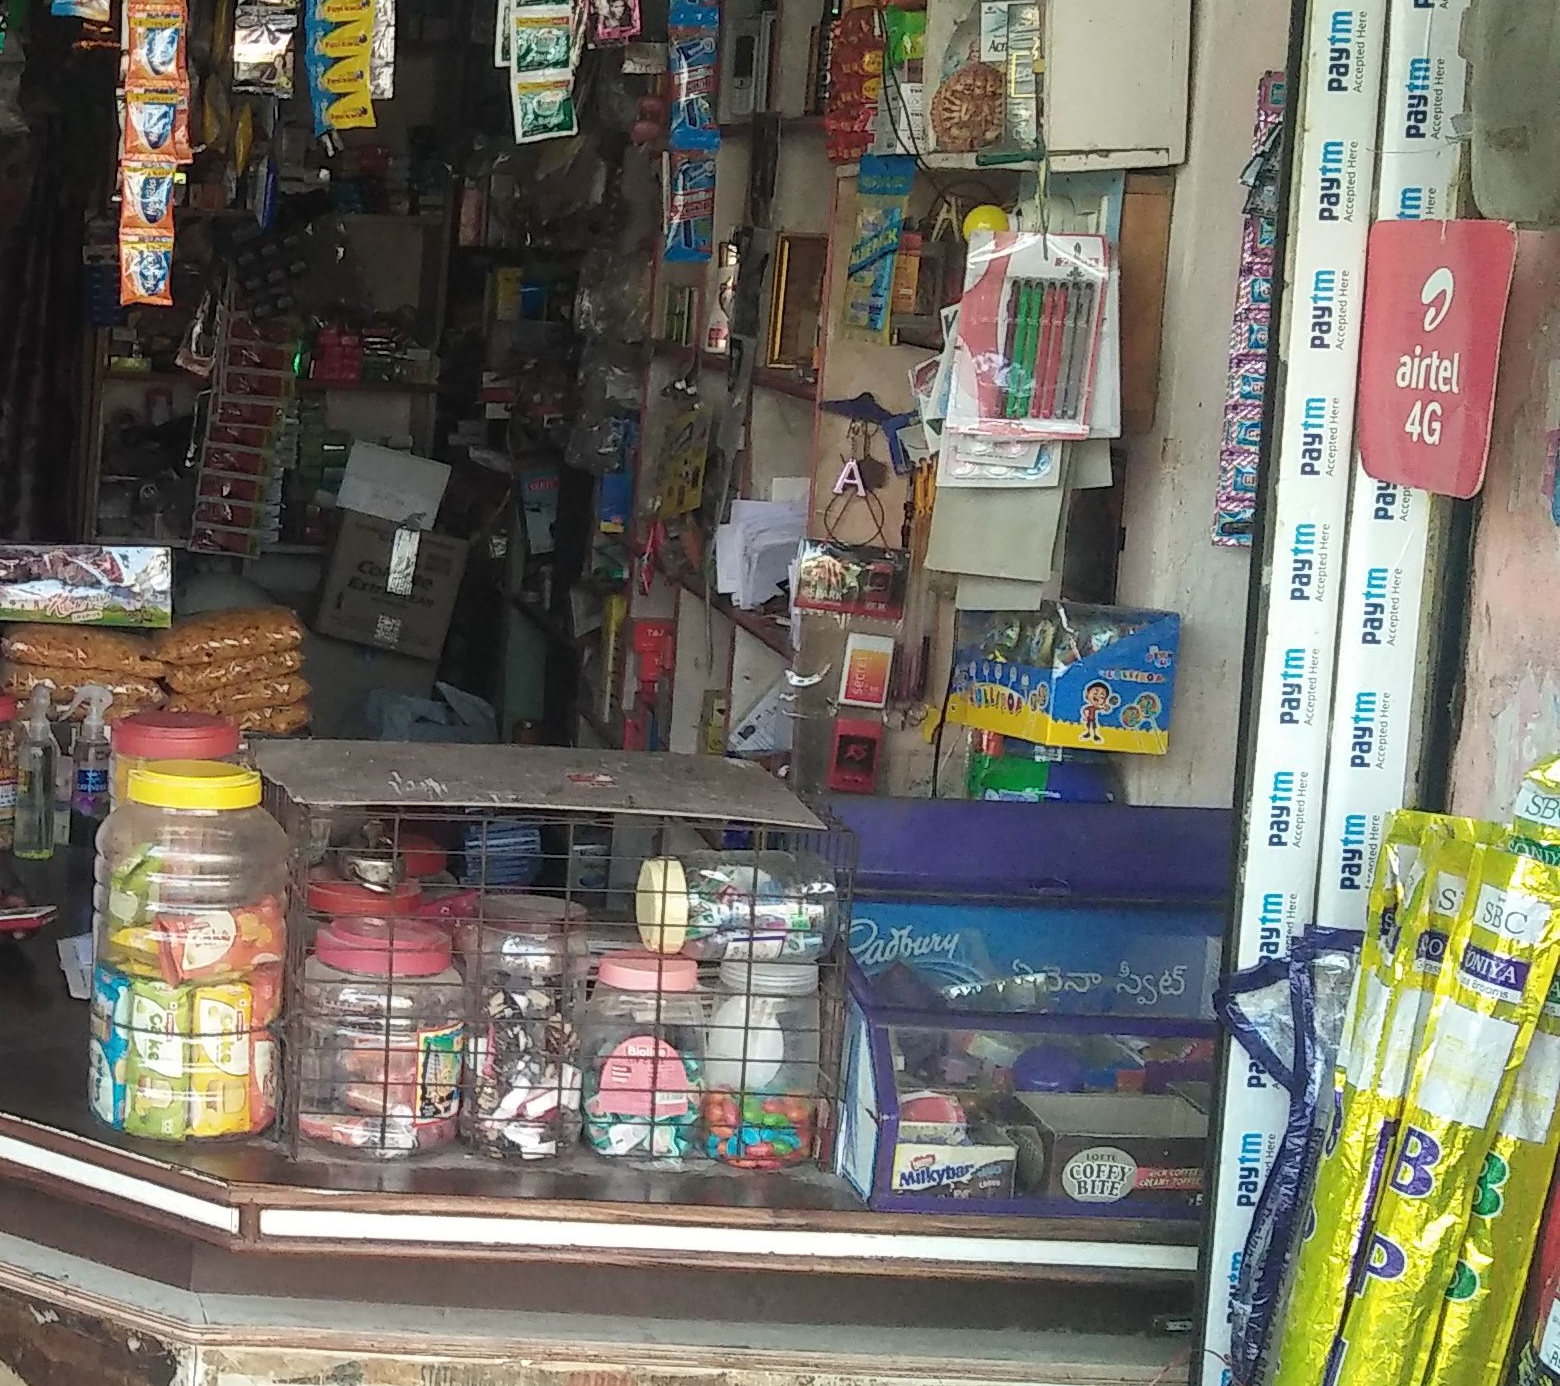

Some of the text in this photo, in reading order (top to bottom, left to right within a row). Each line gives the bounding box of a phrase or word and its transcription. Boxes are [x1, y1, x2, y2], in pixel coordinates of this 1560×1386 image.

[1327, 10, 1353, 93] Paytm
[1352, 10, 1368, 93] Accepted Here
[1405, 57, 1432, 140] Paytm
[1430, 58, 1445, 140] Accepted Here
[1319, 140, 1344, 224] Paytm
[1343, 140, 1359, 224] Accepted Here
[1310, 269, 1336, 351] Paytm
[1334, 269, 1351, 351] Accepted Here
[1396, 349, 1460, 395] airtel
[1301, 396, 1327, 477] Paytm
[1324, 396, 1340, 477] Accepted Here
[1404, 401, 1444, 445] 4G
[1374, 478, 1397, 522] Pay
[1290, 523, 1316, 602] Paytm
[1314, 523, 1330, 602] Accepted Here
[1361, 566, 1389, 646] Paytm
[1387, 567, 1403, 646] Accepted Here
[853, 656, 868, 697] secret
[1280, 648, 1306, 725] Paytm
[1304, 648, 1320, 726] Accepted Here
[1350, 690, 1377, 769] Paytm
[1375, 691, 1391, 770] Accepted Here
[1269, 771, 1294, 847] Paytm
[1293, 771, 1309, 848] Accepted Here
[1368, 814, 1380, 840] Here
[1339, 813, 1366, 890] Paytm
[844, 917, 960, 964] Cadbury
[1482, 901, 1528, 935] SBC
[1464, 949, 1516, 985] ONIYA
[148, 1012, 163, 1061] Cake
[626, 1045, 668, 1057] Biolie
[898, 1162, 975, 1190] Milkybar
[1068, 1164, 1134, 1183] COFFY
[1076, 1180, 1120, 1197] BITE
